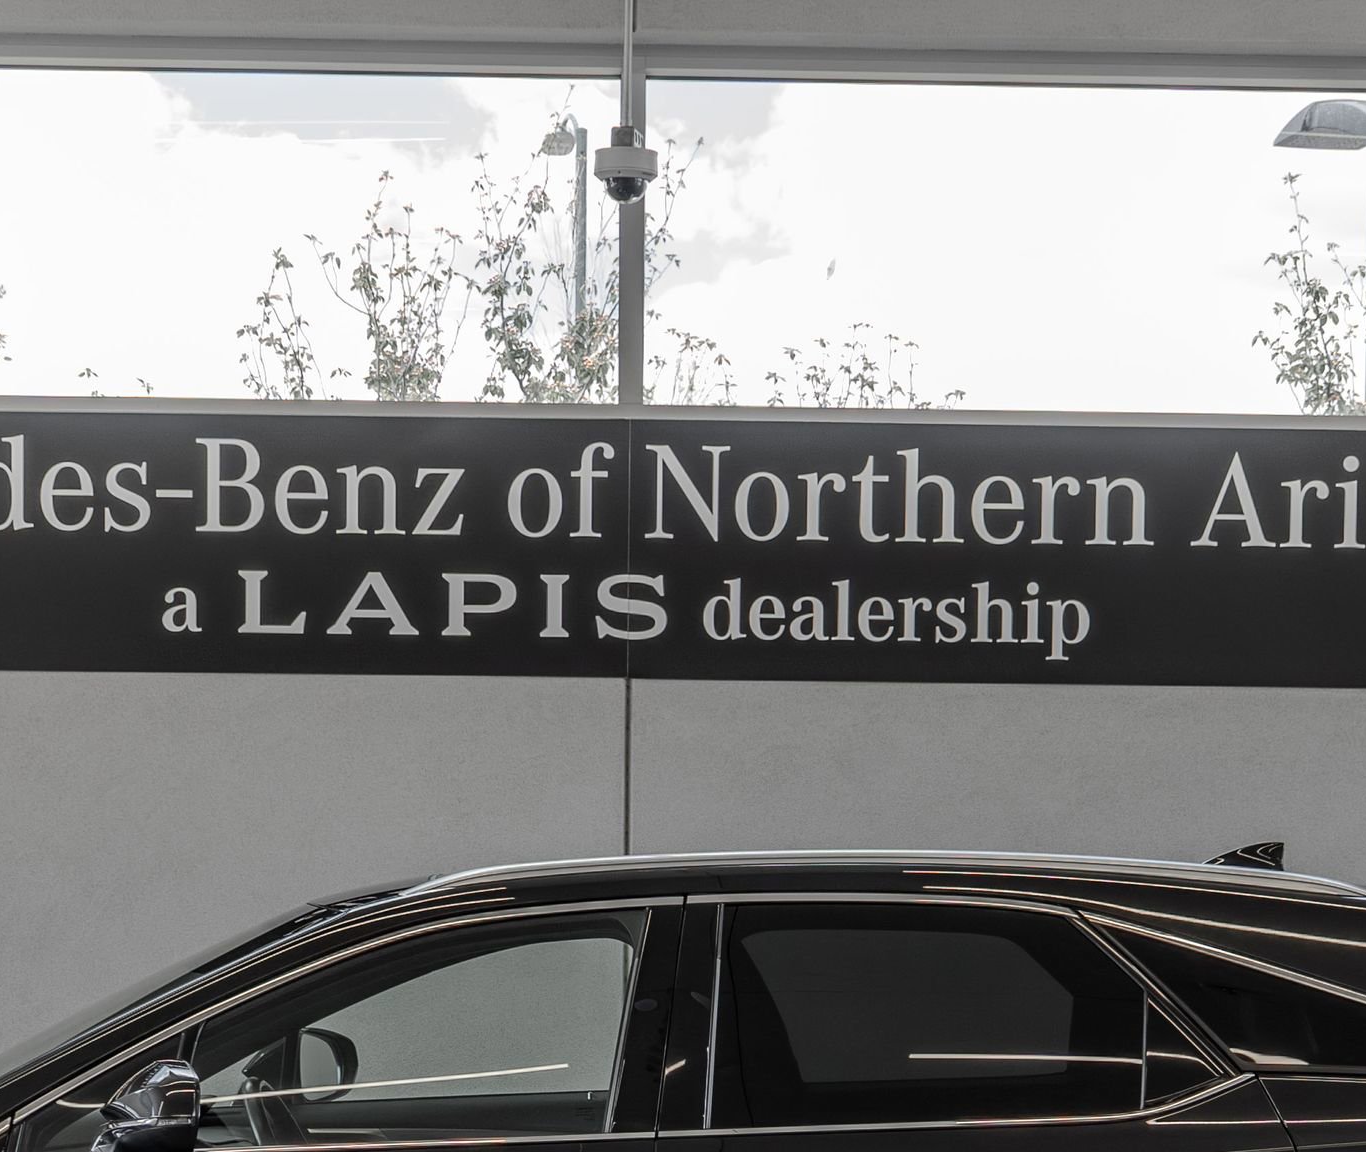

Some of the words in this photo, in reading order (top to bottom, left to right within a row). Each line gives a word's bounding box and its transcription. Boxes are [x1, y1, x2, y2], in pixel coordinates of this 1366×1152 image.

[508, 442, 615, 538] of
[645, 445, 1155, 546] Northern
[162, 588, 203, 633] a
[238, 570, 669, 641] LAPIS
[703, 578, 1090, 661] dealership
